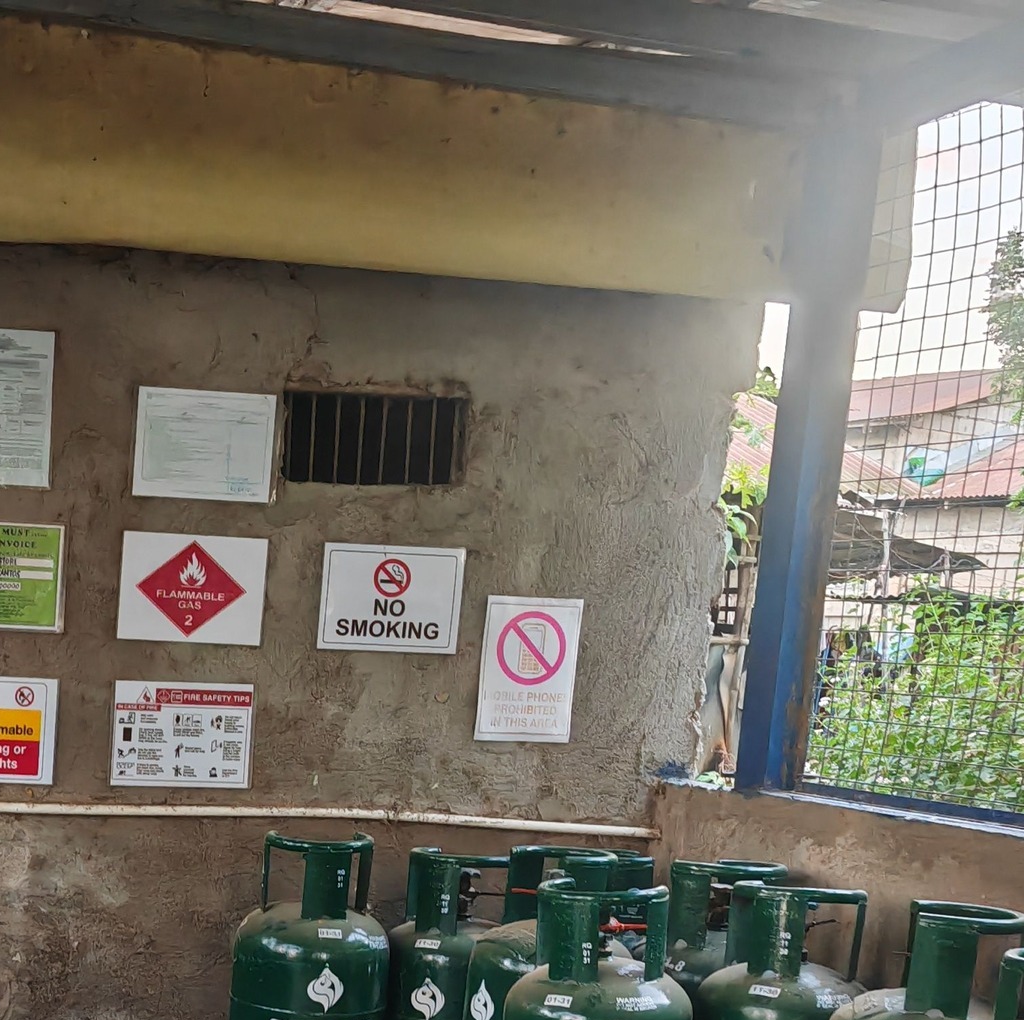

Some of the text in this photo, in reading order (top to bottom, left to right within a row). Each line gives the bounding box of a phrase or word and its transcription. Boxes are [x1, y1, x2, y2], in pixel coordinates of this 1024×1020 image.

[2, 528, 30, 537] MUST
[156, 589, 225, 602] FLAMMABLE
[178, 600, 202, 610] GAS
[373, 598, 406, 617] NO
[184, 614, 193, 626] 2
[335, 618, 440, 640] SMOKING
[183, 694, 200, 702] FIRE
[202, 694, 232, 702] SAFETY
[484, 690, 526, 702] OBILE
[494, 703, 558, 716] PROHIBITED
[490, 716, 558, 728] IN THIS AREA
[13, 745, 27, 754] or
[546, 997, 570, 1005] 01-31
